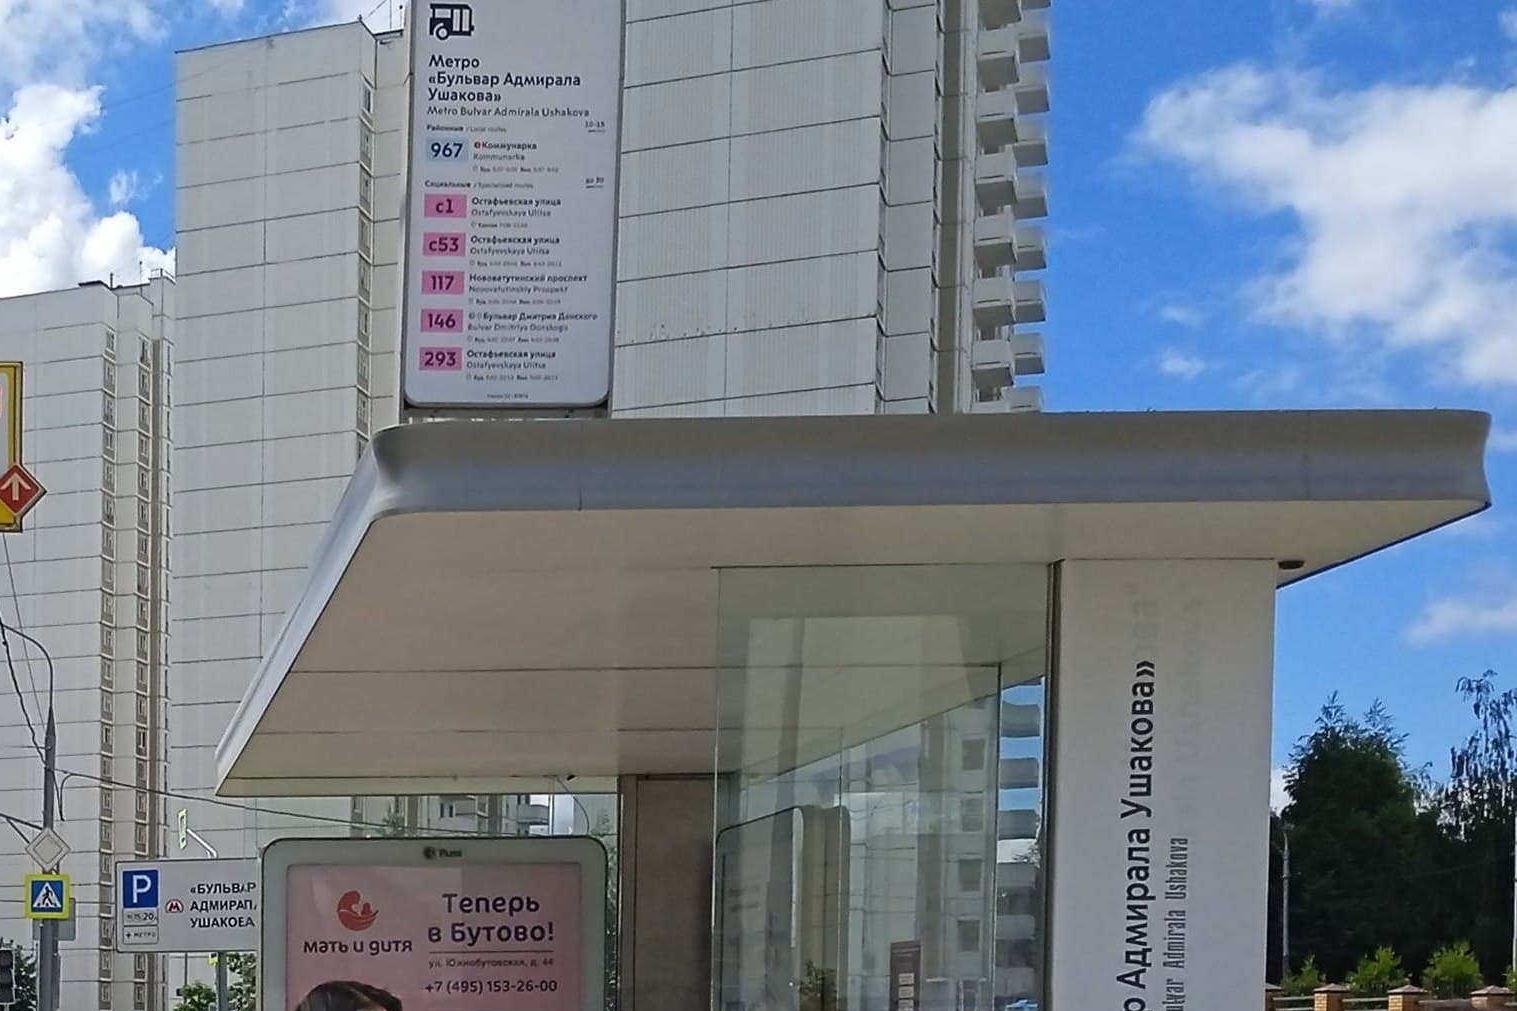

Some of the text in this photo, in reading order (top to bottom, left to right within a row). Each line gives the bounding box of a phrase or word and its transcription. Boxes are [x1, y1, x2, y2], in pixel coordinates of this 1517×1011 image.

[428, 54, 480, 69] Метро
[428, 70, 581, 88] «Бульвар Адмирала
[427, 88, 502, 102] Ушакова»
[427, 107, 590, 118] Metro Bulvar Admirala Ushakova
[430, 142, 464, 158] 967
[534, 198, 562, 207] улица
[532, 237, 560, 246] улица
[430, 275, 455, 290] 117
[427, 313, 456, 328] 146
[423, 351, 457, 367] 293
[528, 350, 556, 360] улица
[1120, 660, 1156, 819] Ушакова»
[1165, 837, 1189, 900] Ushakova
[442, 893, 540, 916] Теперь
[1116, 828, 1157, 989] Адмирала
[428, 922, 554, 947] в Бутово!
[1162, 909, 1186, 969] Admirala
[303, 939, 349, 954] мать
[425, 979, 558, 995] +7 (495) 153-26-00
